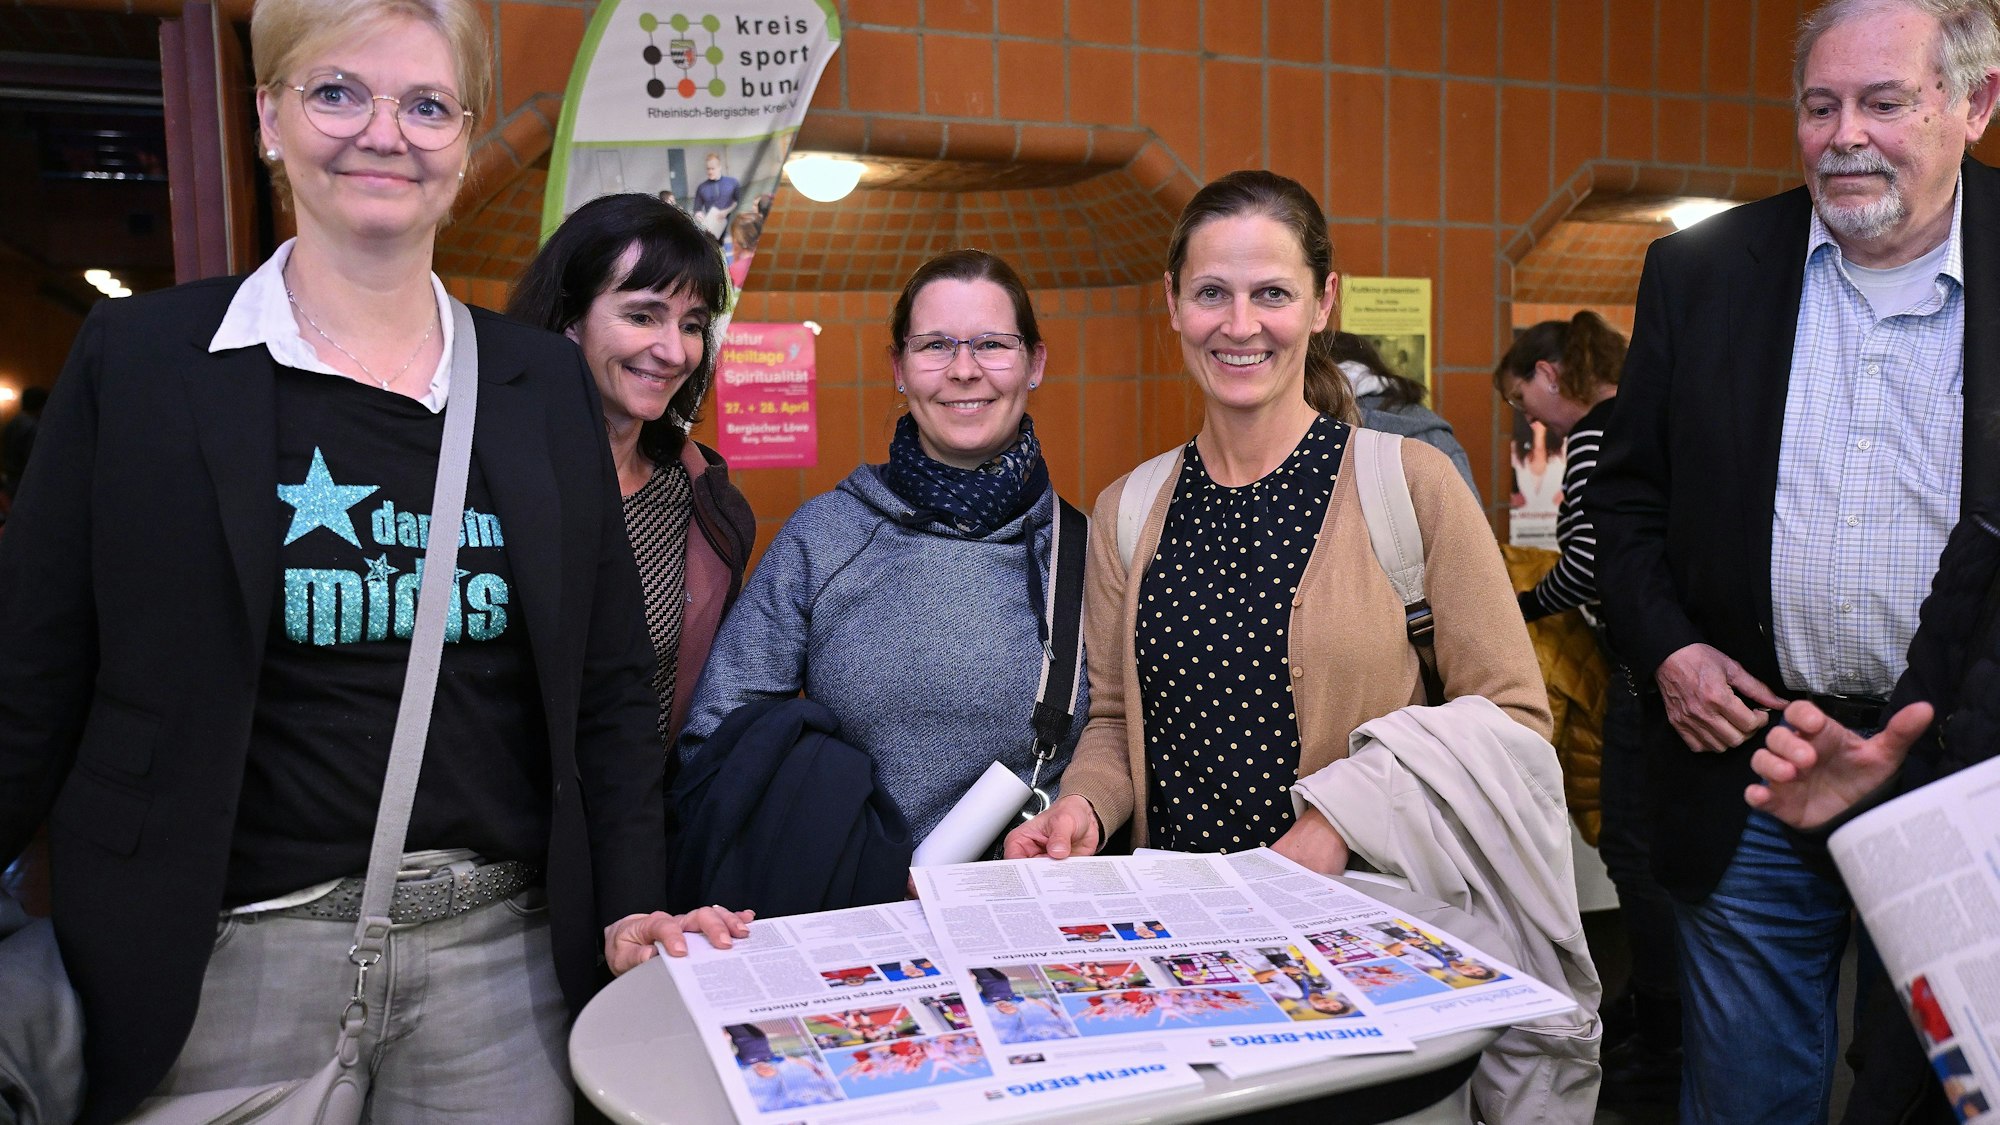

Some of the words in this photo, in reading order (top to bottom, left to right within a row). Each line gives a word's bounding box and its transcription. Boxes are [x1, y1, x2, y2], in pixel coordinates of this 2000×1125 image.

[736, 15, 808, 35] kreis
[740, 45, 808, 70] sport
[742, 77, 799, 97] bun
[648, 106, 760, 120] Rheinisch-Bergischer
[724, 332, 764, 346] Natur
[725, 370, 808, 386] Spiritualität
[725, 402, 745, 414] 27.
[781, 401, 809, 415] April
[727, 423, 780, 436] Bergischer
[784, 422, 809, 432] Löwe
[1189, 938, 1241, 948] Applaus
[1244, 935, 1288, 943] Großer
[993, 951, 1048, 961] Athleten
[1089, 944, 1168, 955] Rhein-Bergs
[749, 1001, 809, 1014] Athleten
[1231, 1027, 1384, 1047] RHEIN-BERG
